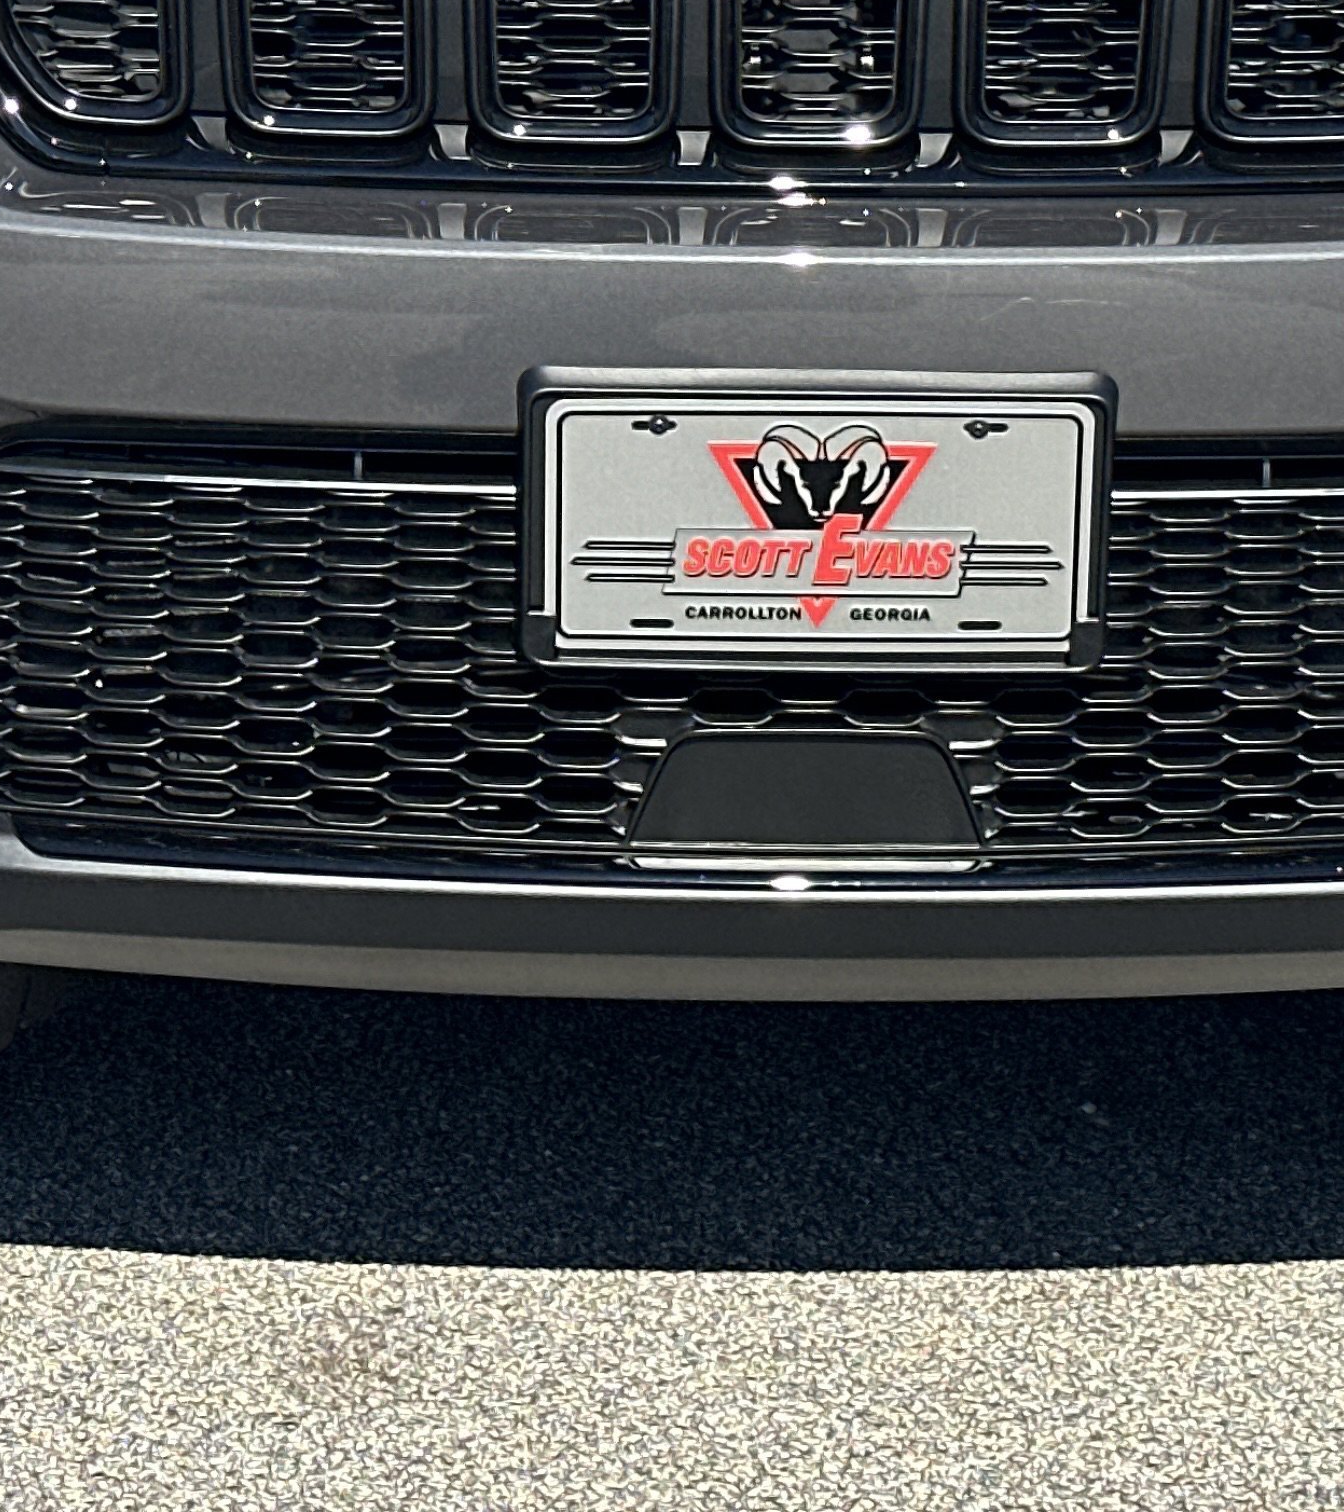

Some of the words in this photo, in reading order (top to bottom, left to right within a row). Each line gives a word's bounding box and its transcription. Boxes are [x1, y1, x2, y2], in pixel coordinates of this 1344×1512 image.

[682, 537, 812, 578] SCOTT
[812, 513, 955, 586] EVANS
[684, 605, 803, 622] CARROLLTON
[849, 607, 932, 622] GEORGIA
